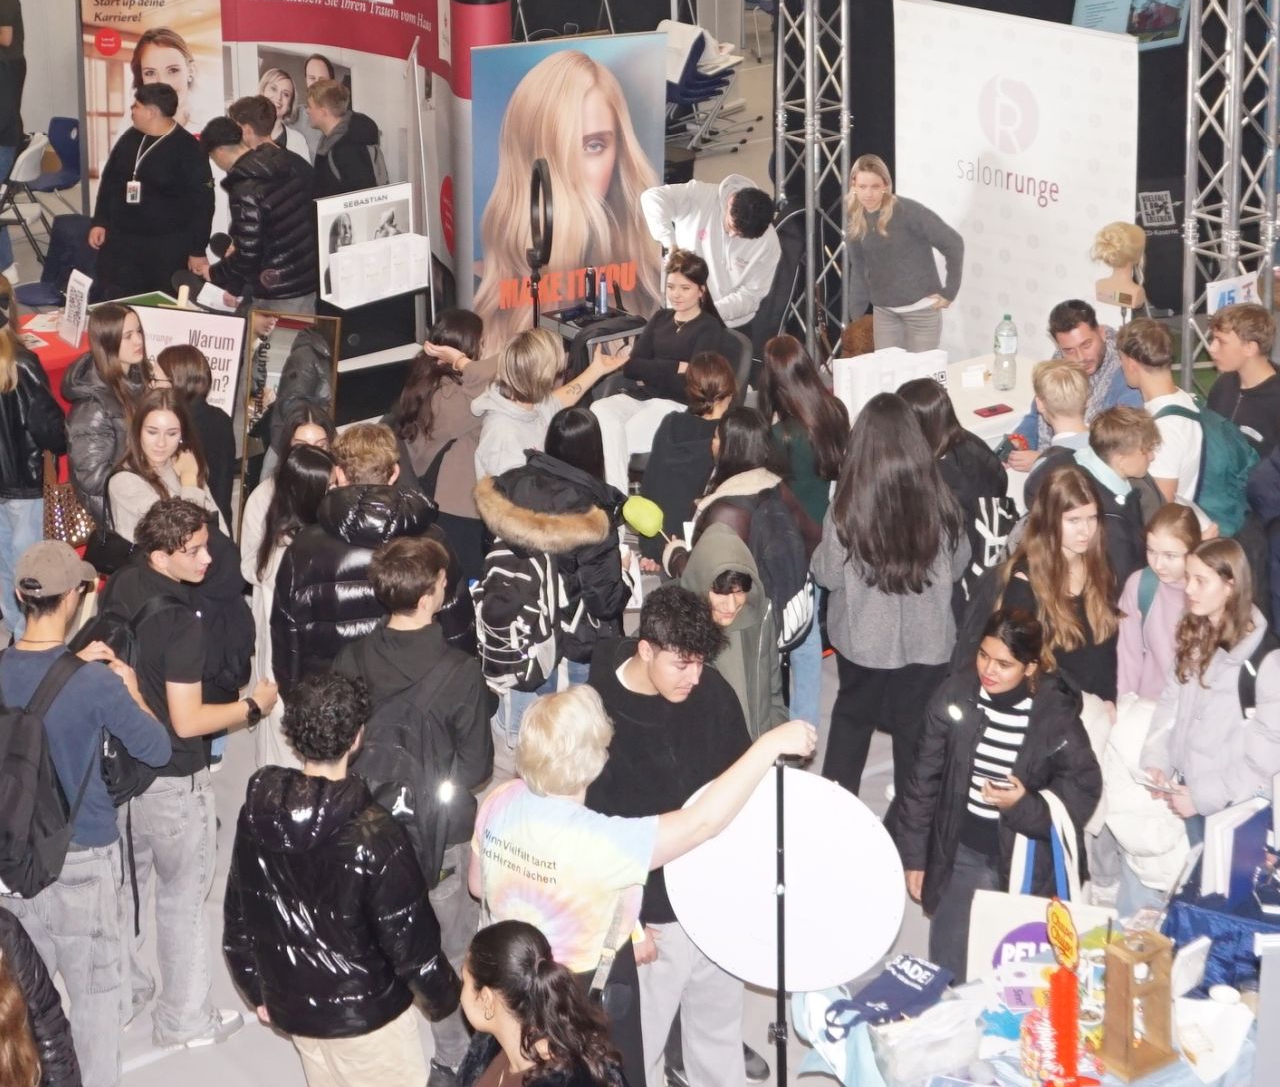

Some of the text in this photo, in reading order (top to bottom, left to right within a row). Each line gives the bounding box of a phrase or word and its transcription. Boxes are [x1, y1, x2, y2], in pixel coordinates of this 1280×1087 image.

[122, 0, 136, 9] up
[370, 1, 399, 19] Traum
[400, 10, 417, 24] vom
[94, 12, 142, 23] Karriere!
[956, 156, 1059, 208] salonrunge
[343, 194, 389, 209] SEBASTIAN
[499, 272, 563, 310] MAKE
[189, 329, 235, 351] Warum
[532, 855, 557, 870] tanzt
[523, 867, 557, 885] lachen
